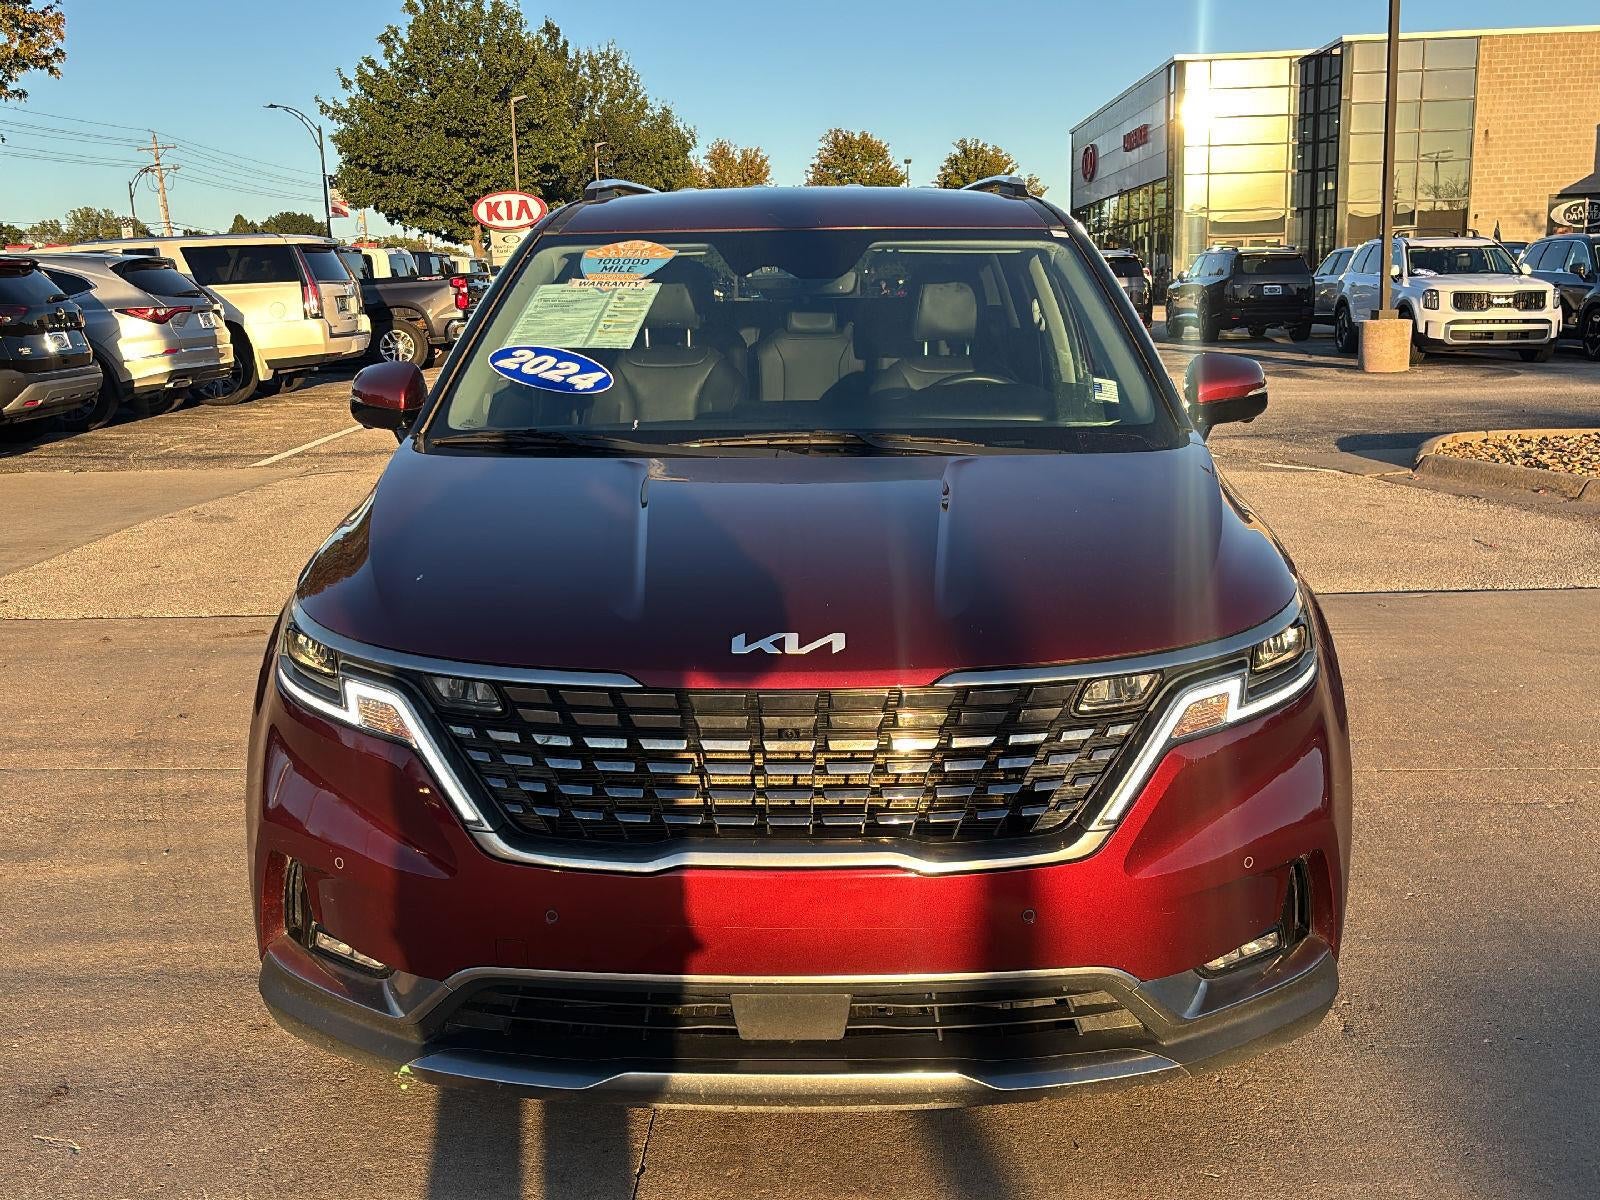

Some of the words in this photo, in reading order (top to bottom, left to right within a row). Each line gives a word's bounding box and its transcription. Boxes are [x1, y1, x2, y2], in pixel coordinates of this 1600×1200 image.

[485, 200, 534, 221] KIA
[494, 350, 607, 390] 2024
[731, 632, 846, 655] KIA
